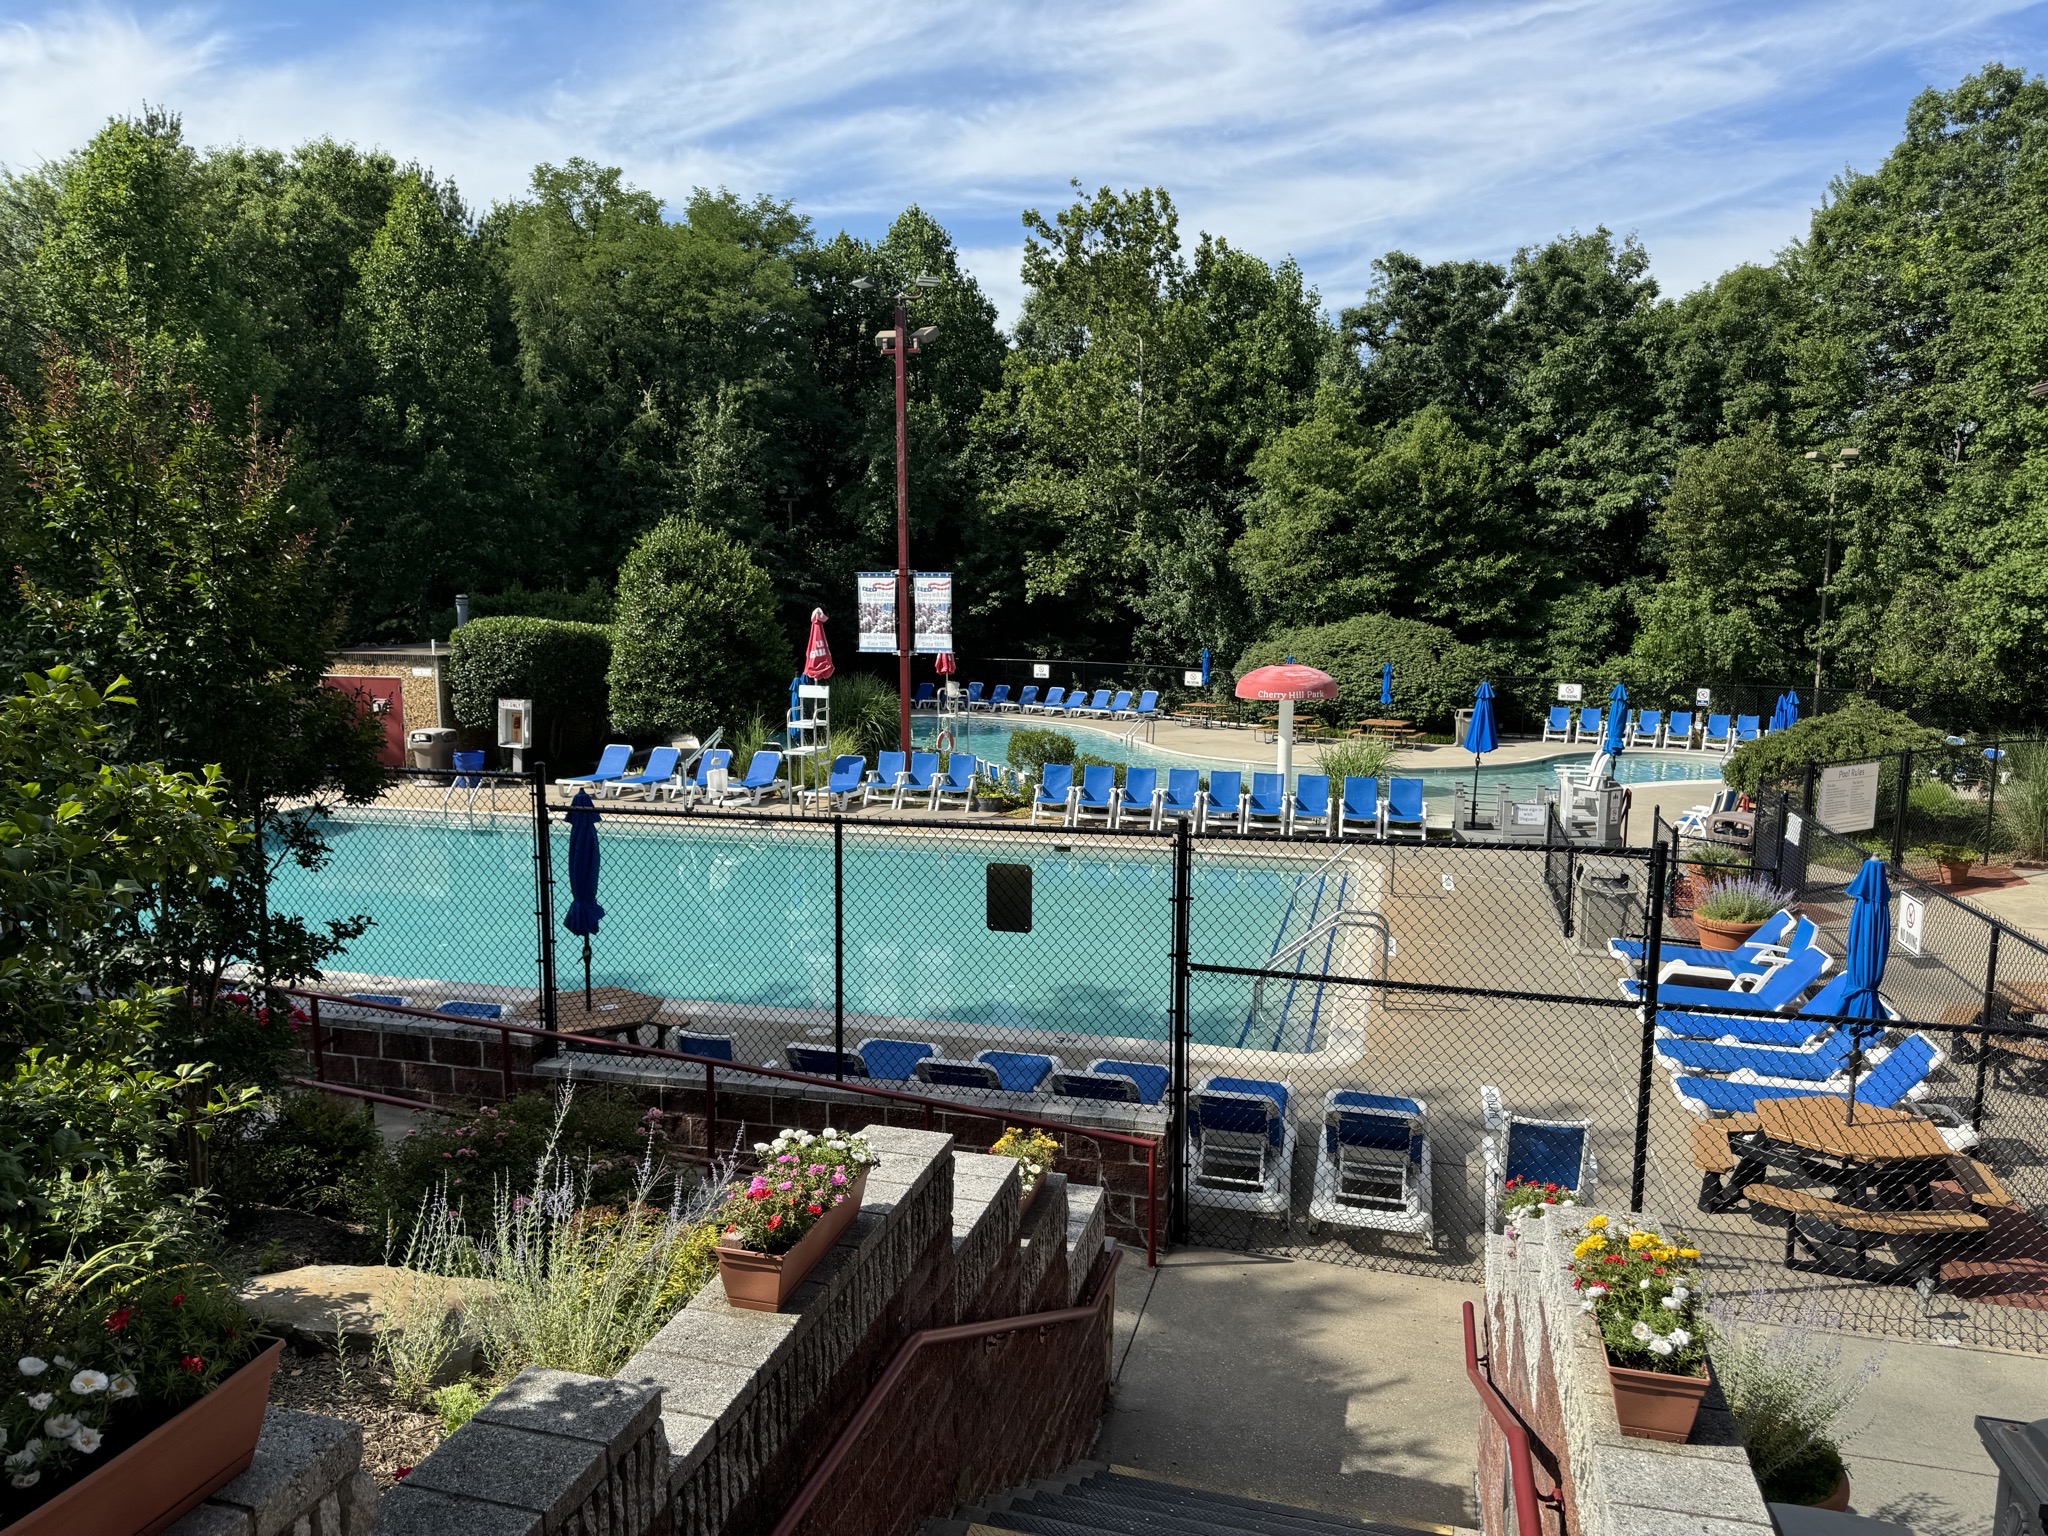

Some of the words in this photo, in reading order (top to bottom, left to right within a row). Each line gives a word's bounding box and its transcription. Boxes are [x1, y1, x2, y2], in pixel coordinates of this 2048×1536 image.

[1257, 690, 1286, 700] Cherry
[1288, 690, 1304, 699] Hill
[1306, 690, 1325, 698] Park
[1838, 769, 1850, 778] Pool
[1851, 768, 1865, 777] Rules
[1900, 927, 1905, 941] NO
[1905, 930, 1917, 950] DIVING
